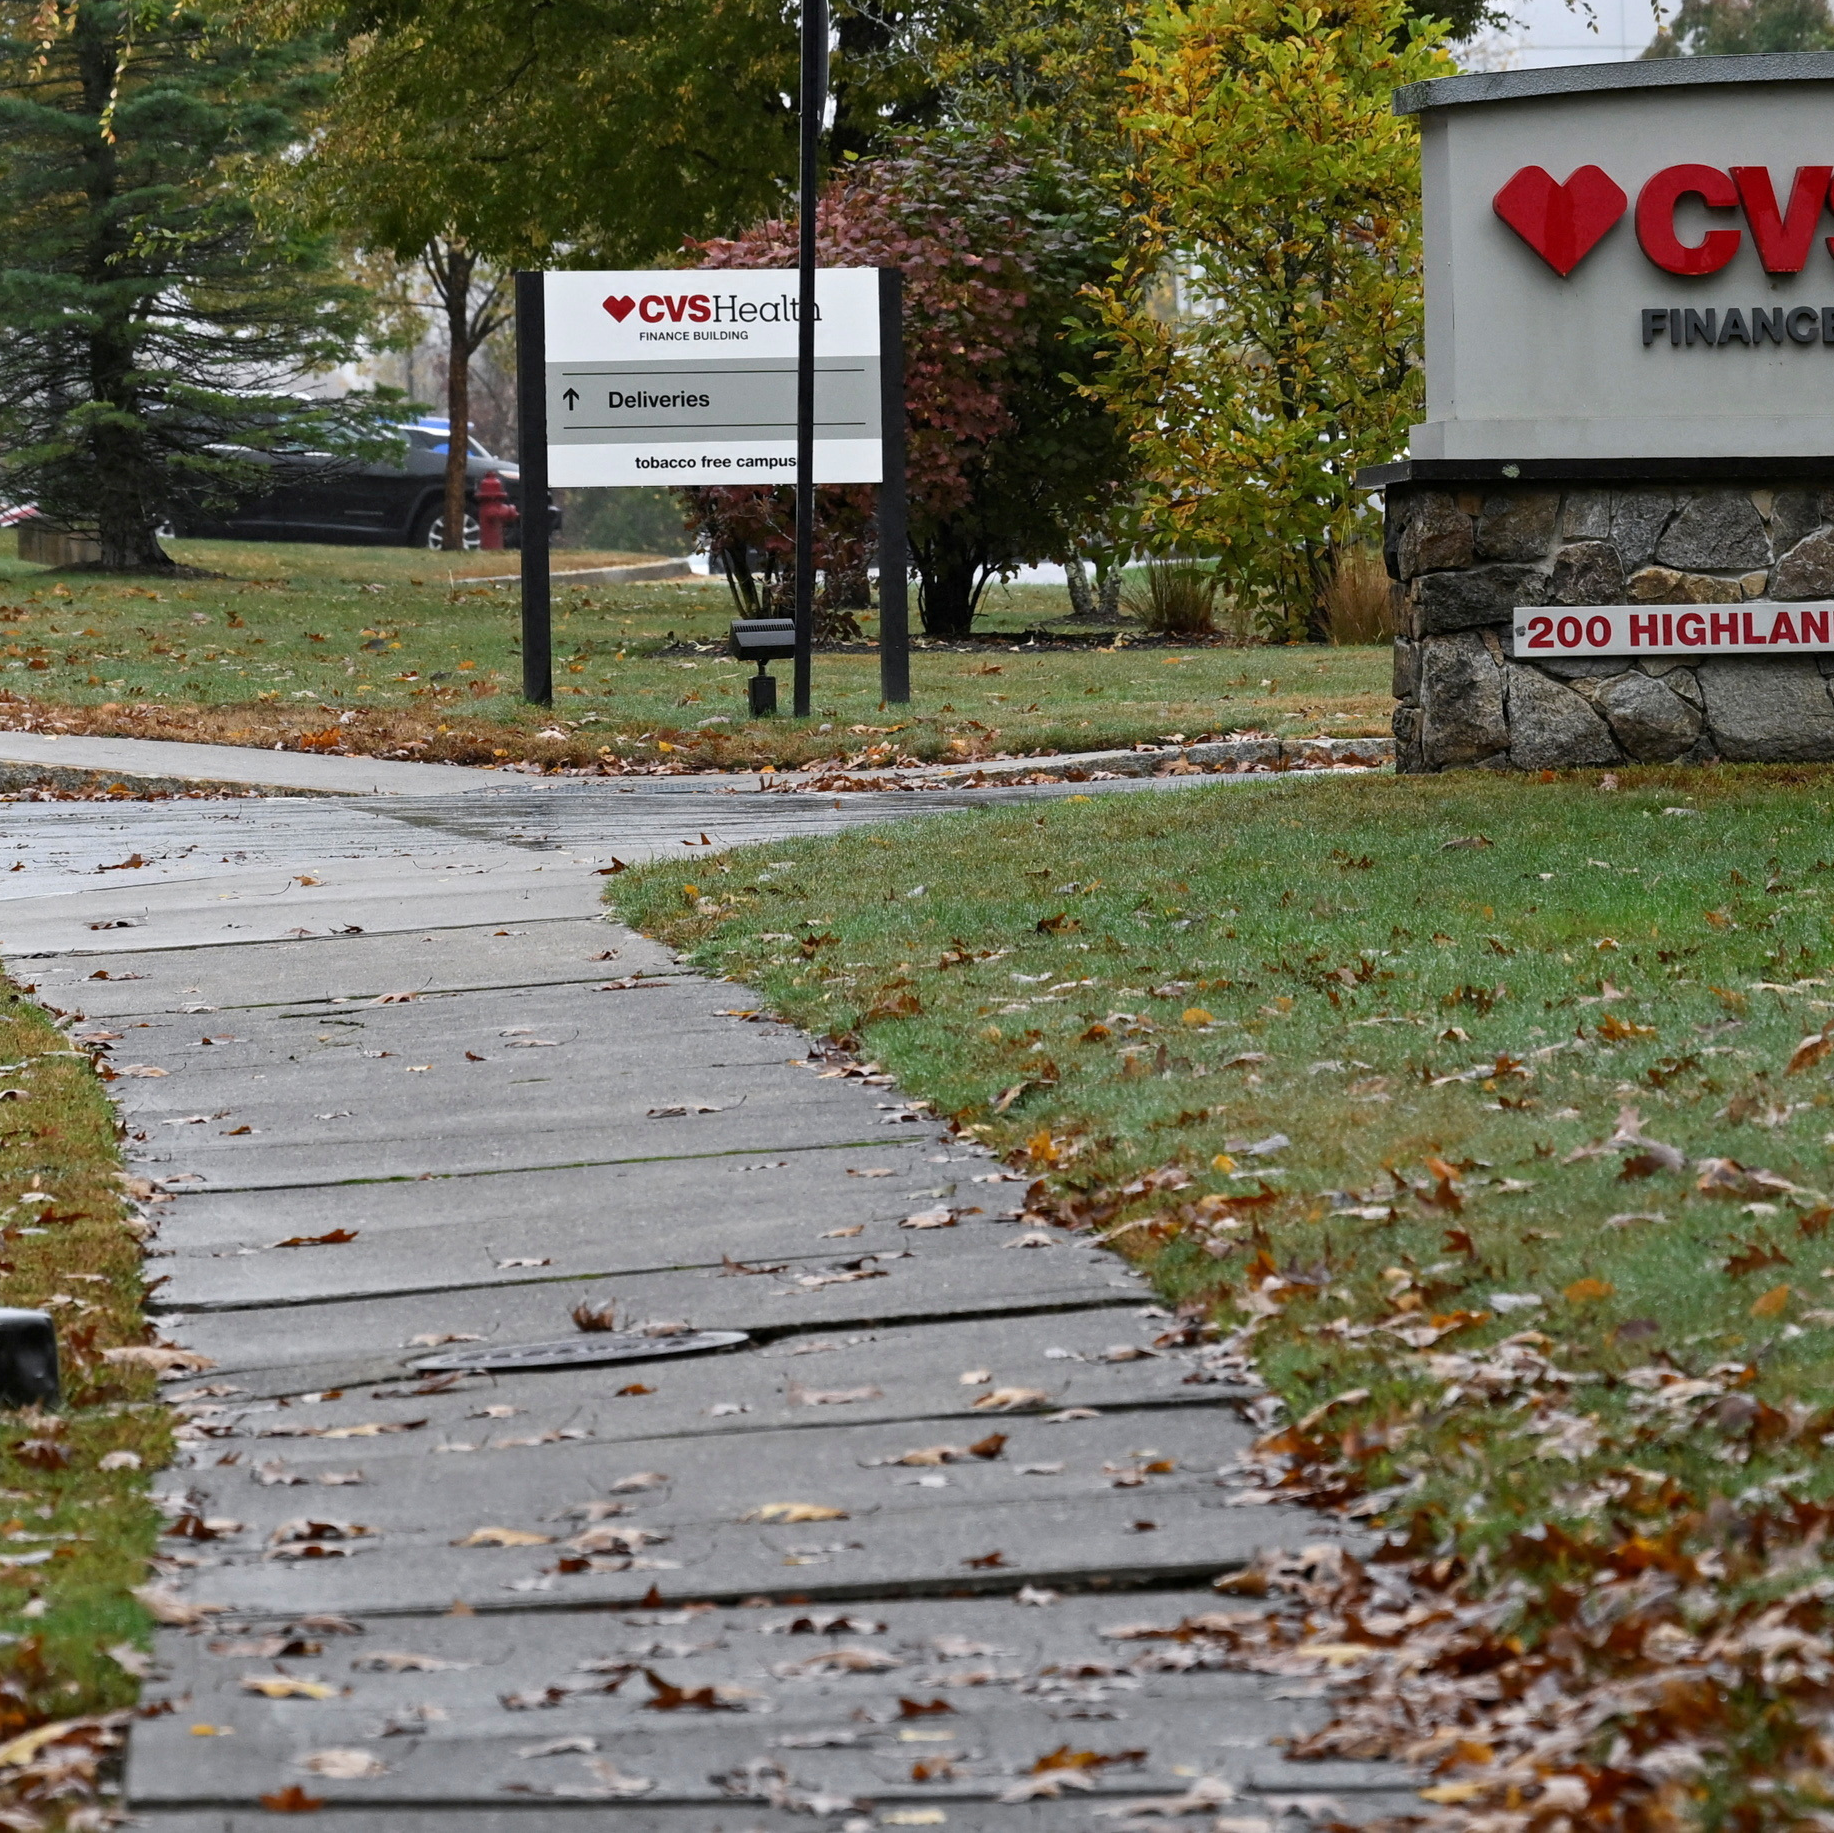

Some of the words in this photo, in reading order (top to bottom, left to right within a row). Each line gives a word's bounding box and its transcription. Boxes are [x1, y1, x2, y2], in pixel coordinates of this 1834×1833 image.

[639, 331, 690, 341] FINANCE
[693, 330, 749, 340] BUILDING
[608, 390, 710, 409] Deliveries
[635, 456, 697, 469] tobacco
[701, 455, 732, 468] free
[736, 456, 797, 470] campus
[1527, 615, 1612, 649] 200
